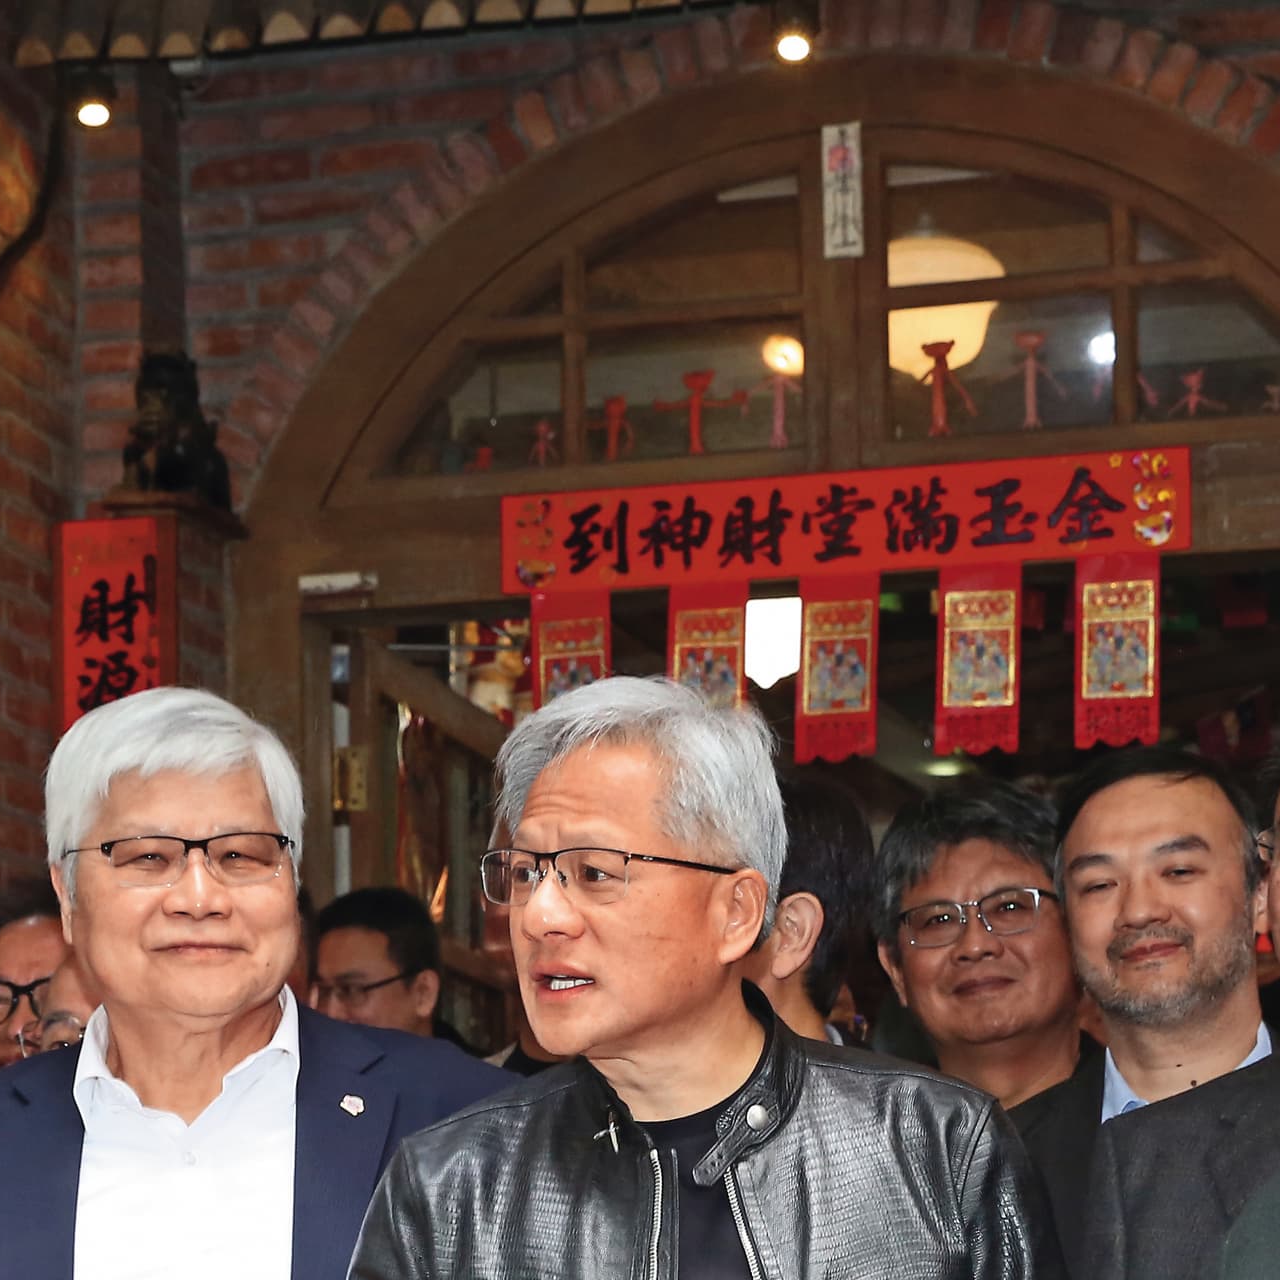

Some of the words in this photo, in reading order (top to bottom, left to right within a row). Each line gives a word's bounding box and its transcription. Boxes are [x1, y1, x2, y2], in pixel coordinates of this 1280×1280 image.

[562, 466, 1126, 575] 金玉滿堂財神到
